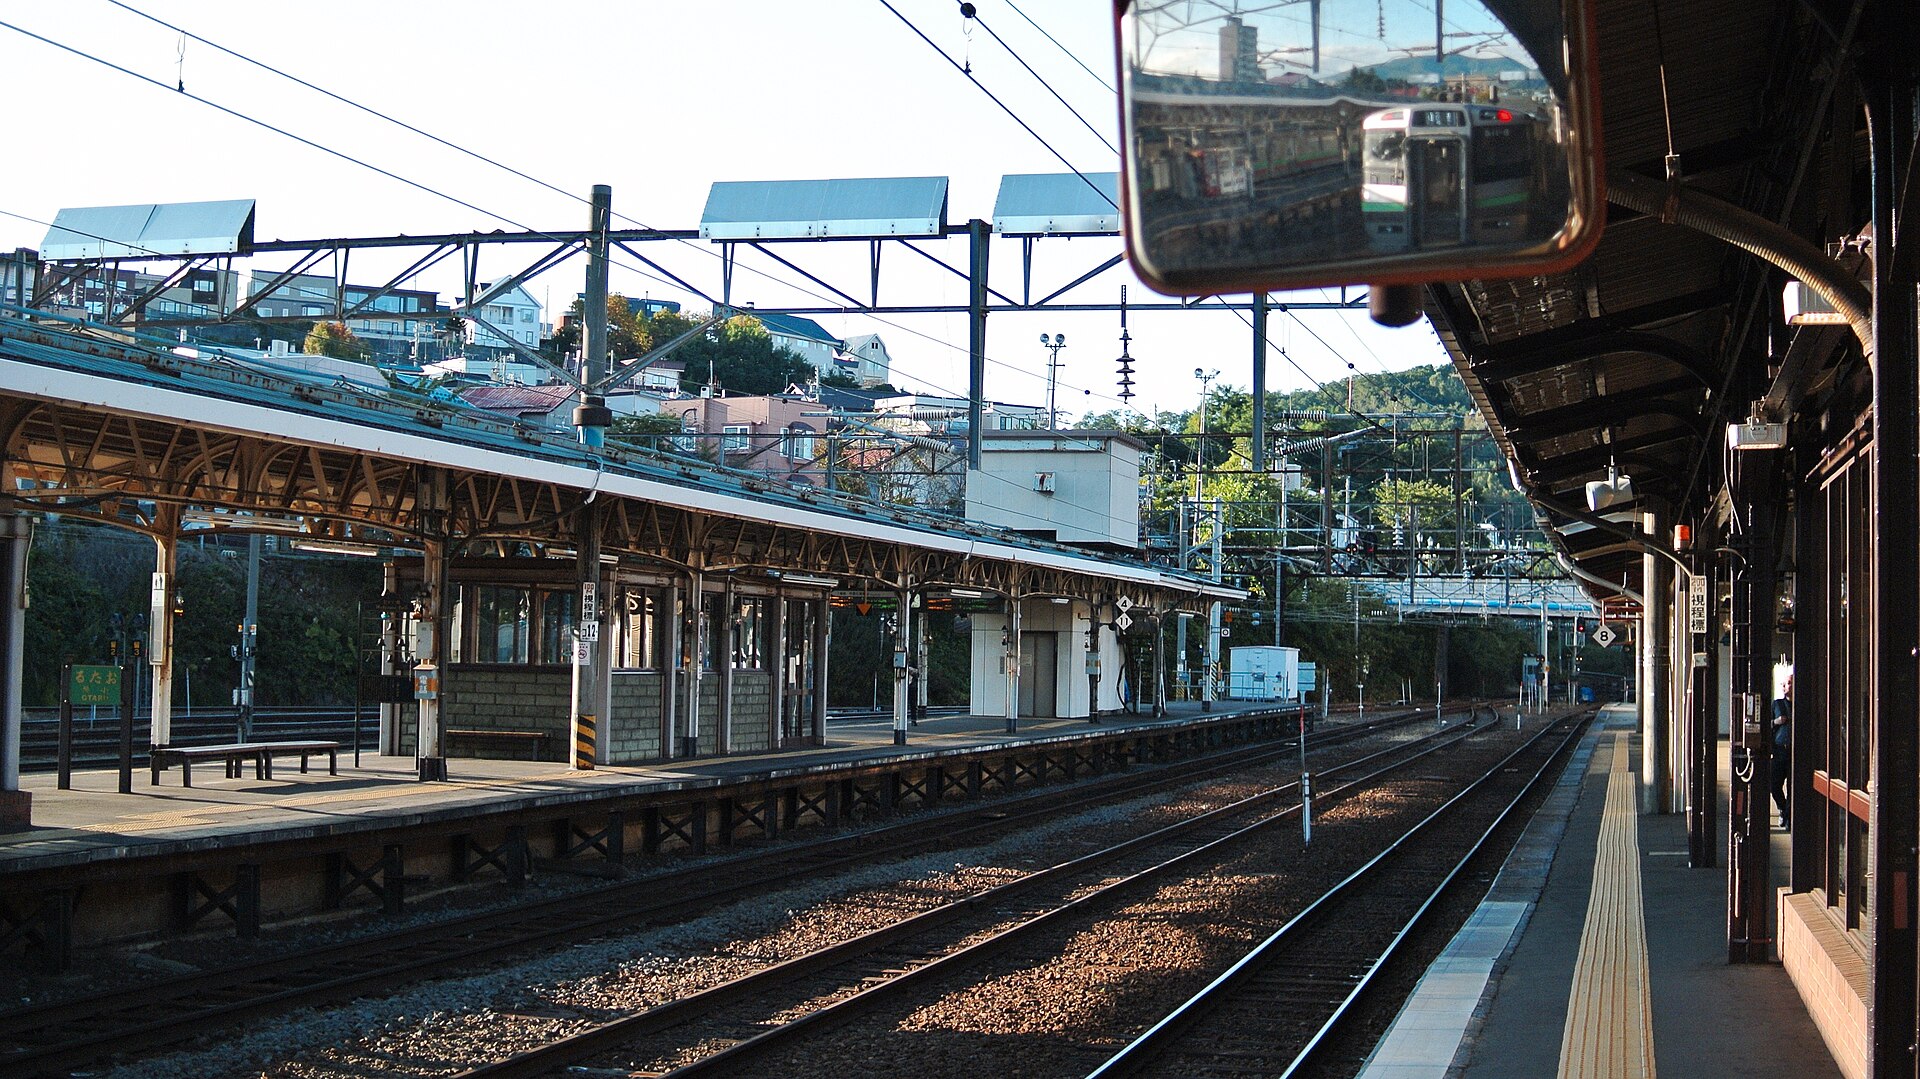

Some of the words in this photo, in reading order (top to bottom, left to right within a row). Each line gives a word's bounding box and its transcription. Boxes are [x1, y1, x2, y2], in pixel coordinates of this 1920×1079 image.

[1691, 578, 1705, 586] 200
[1691, 594, 1705, 630] 視程標
[1120, 617, 1128, 625] 11
[1601, 631, 1608, 641] 8
